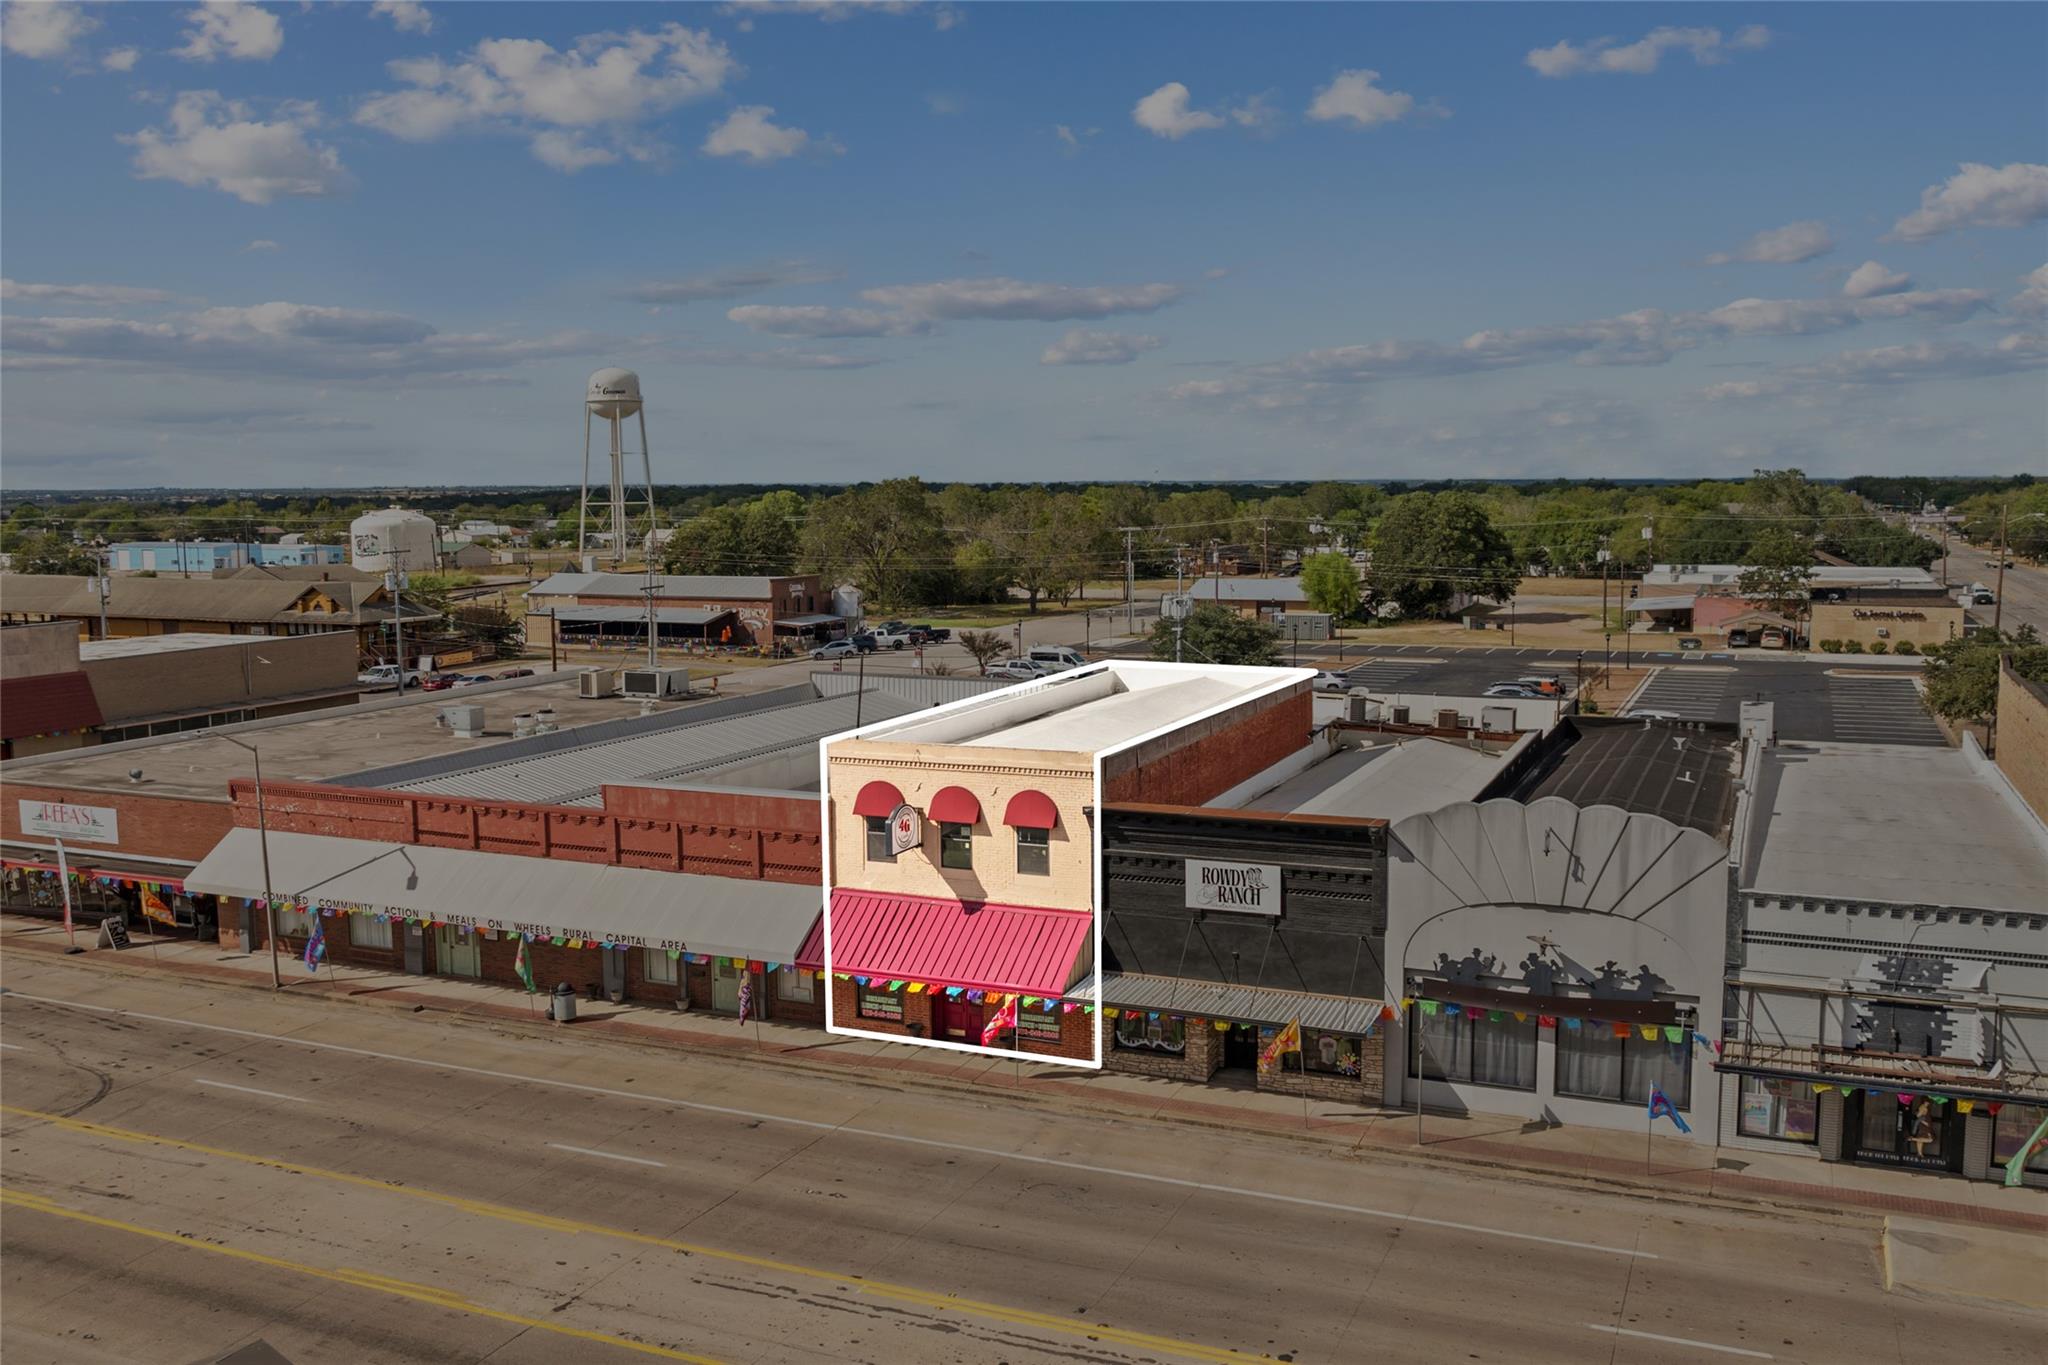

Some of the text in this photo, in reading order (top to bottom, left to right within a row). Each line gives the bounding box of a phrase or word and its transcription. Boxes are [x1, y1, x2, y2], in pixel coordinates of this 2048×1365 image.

[1202, 867, 1250, 887] ROWDY
[1218, 886, 1261, 906] RANCH
[318, 898, 374, 912] COMMUNITY
[384, 906, 419, 918] ACTION
[430, 912, 436, 920] &
[447, 914, 477, 926] MEALS
[488, 919, 503, 929] ON
[514, 922, 551, 935] WHEELS
[562, 928, 594, 940] RURAL
[606, 933, 648, 946] CAPITAL
[661, 939, 688, 951] AREA
